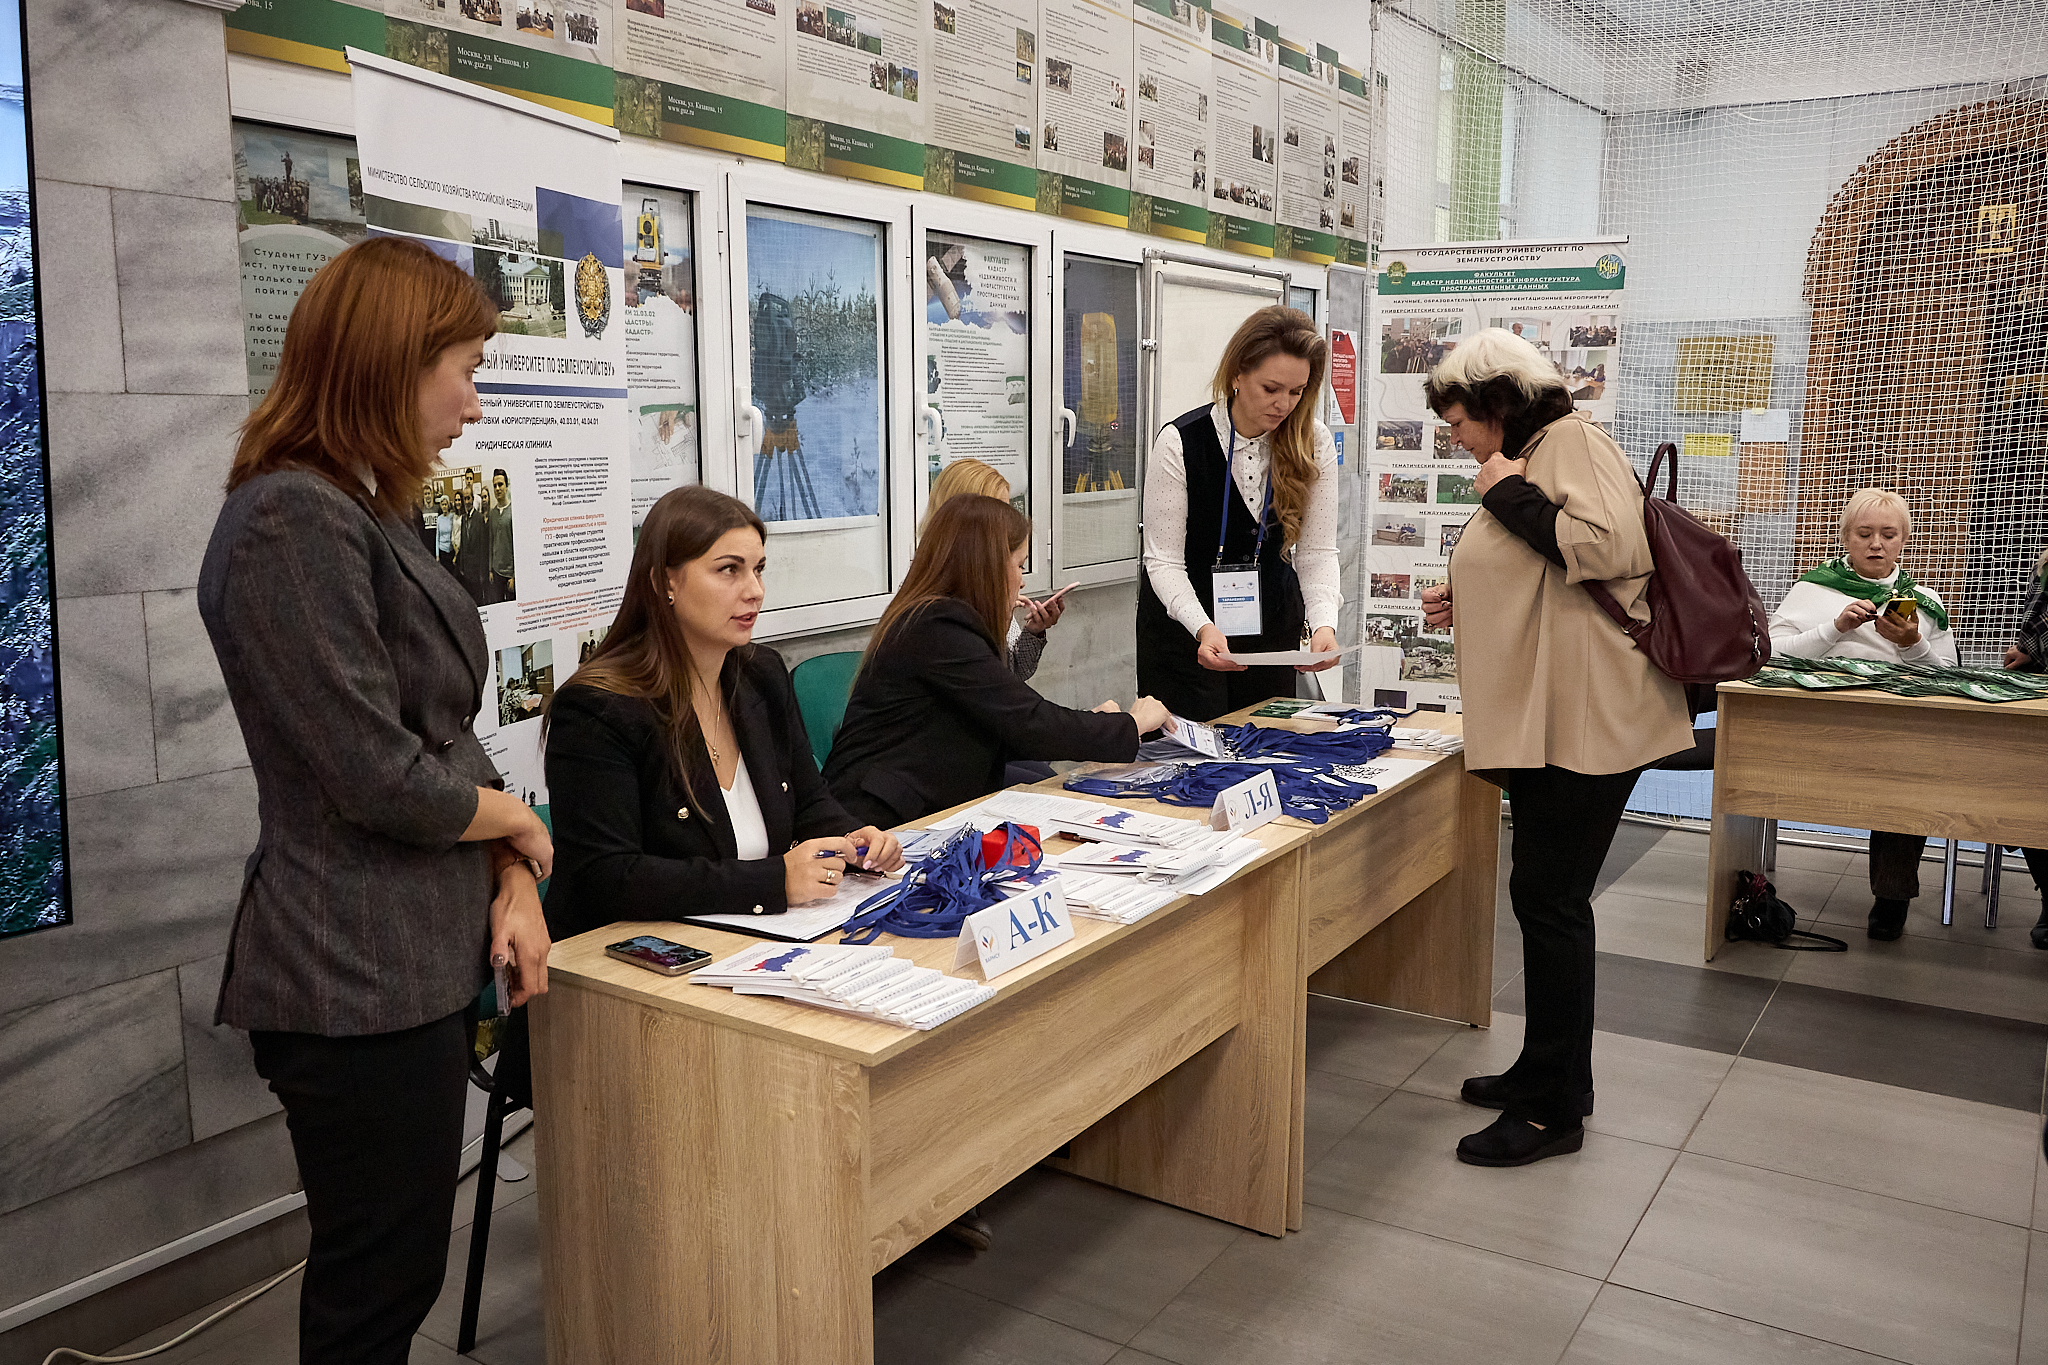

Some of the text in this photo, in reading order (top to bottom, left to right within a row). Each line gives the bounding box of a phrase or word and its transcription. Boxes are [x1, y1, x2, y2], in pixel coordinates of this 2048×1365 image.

[265, 1, 273, 10] 15
[457, 46, 530, 69] Москва, ул. Казакова, 15
[457, 57, 493, 71] www.guz.ru
[668, 95, 687, 107] Москва,
[695, 101, 717, 114] Казакова,
[668, 104, 695, 116] www.guz.ru
[367, 166, 533, 213] МИНИСТЕРСТВО СЕЛЬСКОГО ХОЗЯЙСТВА РОССИЙСКОЙ ФЕДЕРАЦИИ
[254, 248, 301, 260] Студент
[1416, 248, 1503, 257] ГОСУДАРСТВЕННЫЙ
[1506, 246, 1568, 254] УНИВЕРСИТЕТ
[1456, 255, 1542, 263] ЗЕМЛЕУСТРОЙСТВУ
[272, 263, 320, 274] путешес
[253, 274, 292, 284] только
[255, 287, 288, 296] пойти
[268, 313, 288, 321] сме
[500, 352, 545, 373] УНИВЕРСИТЕТ
[547, 357, 556, 373] ПО
[557, 357, 615, 376] ЗЕМЛЕУСТРОЙСТВУ»
[480, 398, 604, 410] ЕННЫЙ УНИВЕРСИТЕТ ПО ЗЕМЛЕУСТРОЙСТВУ»
[501, 417, 558, 427] «ЮРИСПРУДЕНЦИЯ»,
[559, 417, 580, 426] 40.03.01,
[475, 440, 552, 451] ЮРИДИЧЕСКАЯ КЛИНИКА
[1243, 781, 1273, 819] Л-Я
[1009, 891, 1060, 951] А-К
